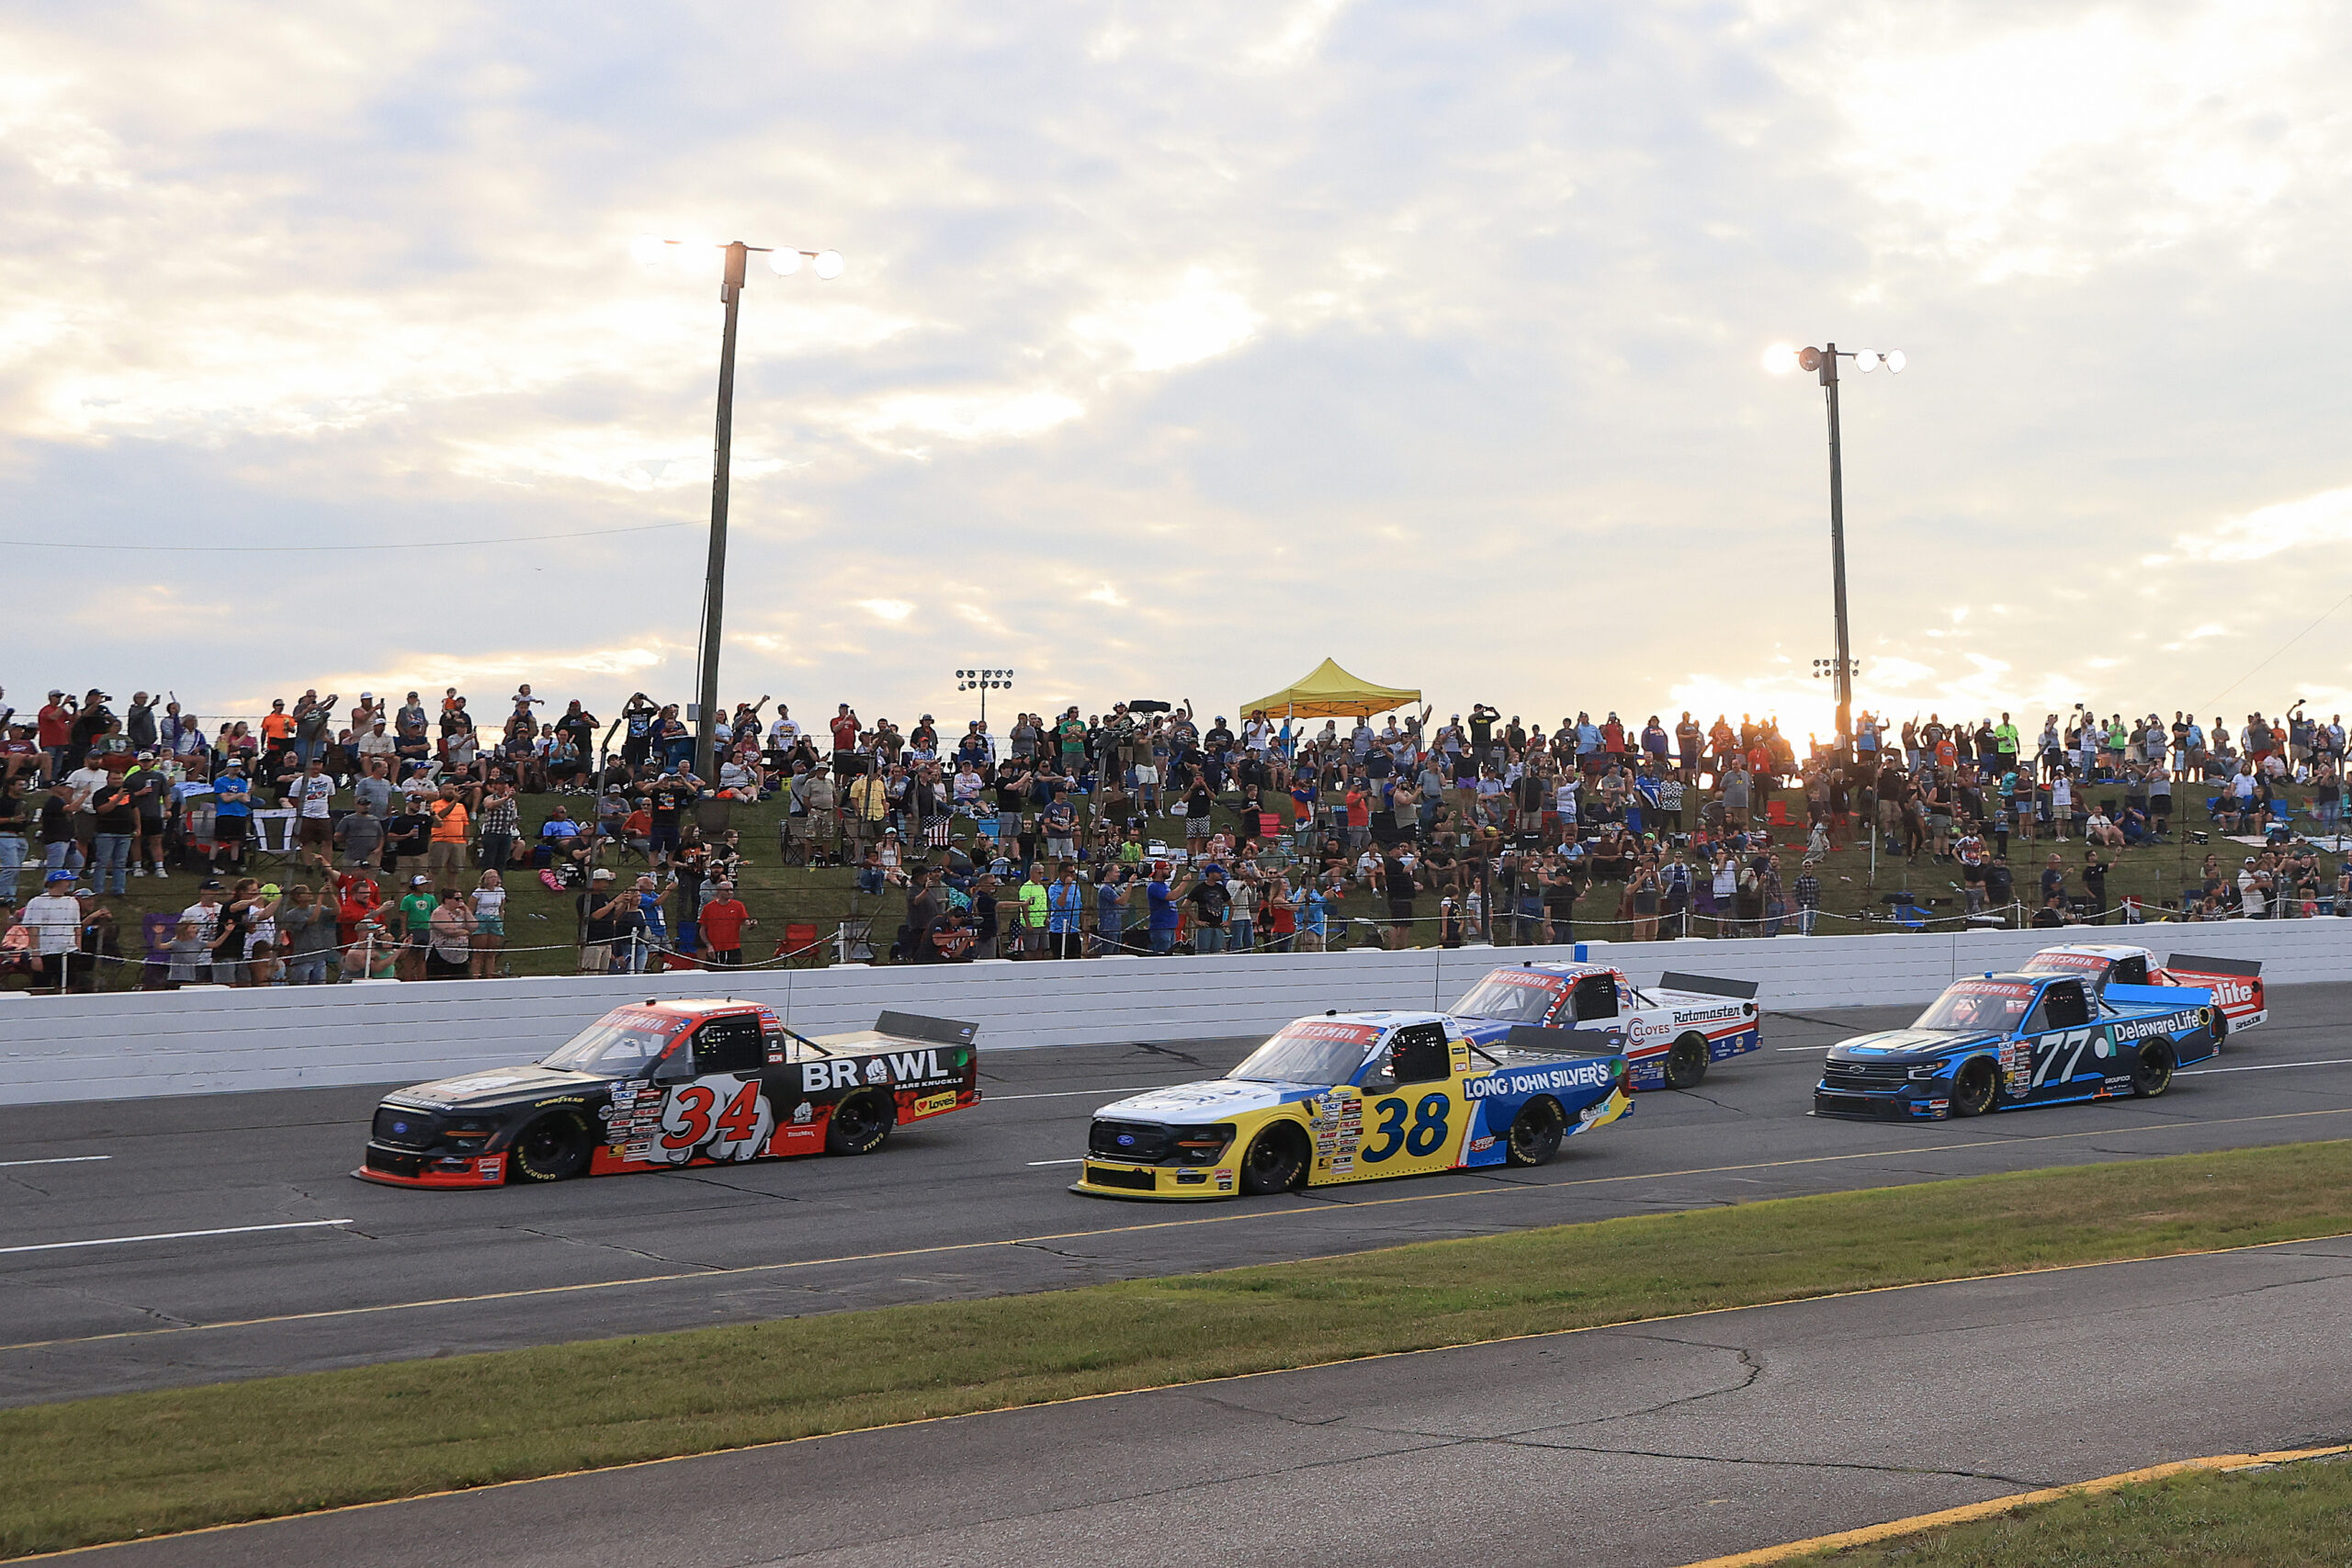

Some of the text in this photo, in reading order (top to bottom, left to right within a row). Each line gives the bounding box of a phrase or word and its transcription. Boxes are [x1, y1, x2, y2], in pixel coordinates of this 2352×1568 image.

[1489, 971, 1550, 987] AFTSMAN
[2210, 981, 2253, 1006] elite
[1672, 1006, 1740, 1023] Rotomaster
[1289, 1024, 1360, 1040] AFTSMAN
[1634, 1024, 1670, 1037] CLOYES
[2113, 1010, 2199, 1042] Delaware Life
[2032, 1028, 2091, 1088] 77
[802, 1050, 949, 1093] BRWL
[1465, 1077, 1509, 1099] LONG
[1511, 1072, 1550, 1095] JOHN
[1550, 1061, 1610, 1088] SILVER'S
[894, 1077, 964, 1090] BARE KNUCKLE
[613, 1090, 637, 1100] SKF
[661, 1080, 762, 1151] 34
[1321, 1102, 1341, 1111] SKF
[1361, 1092, 1451, 1164] 38
